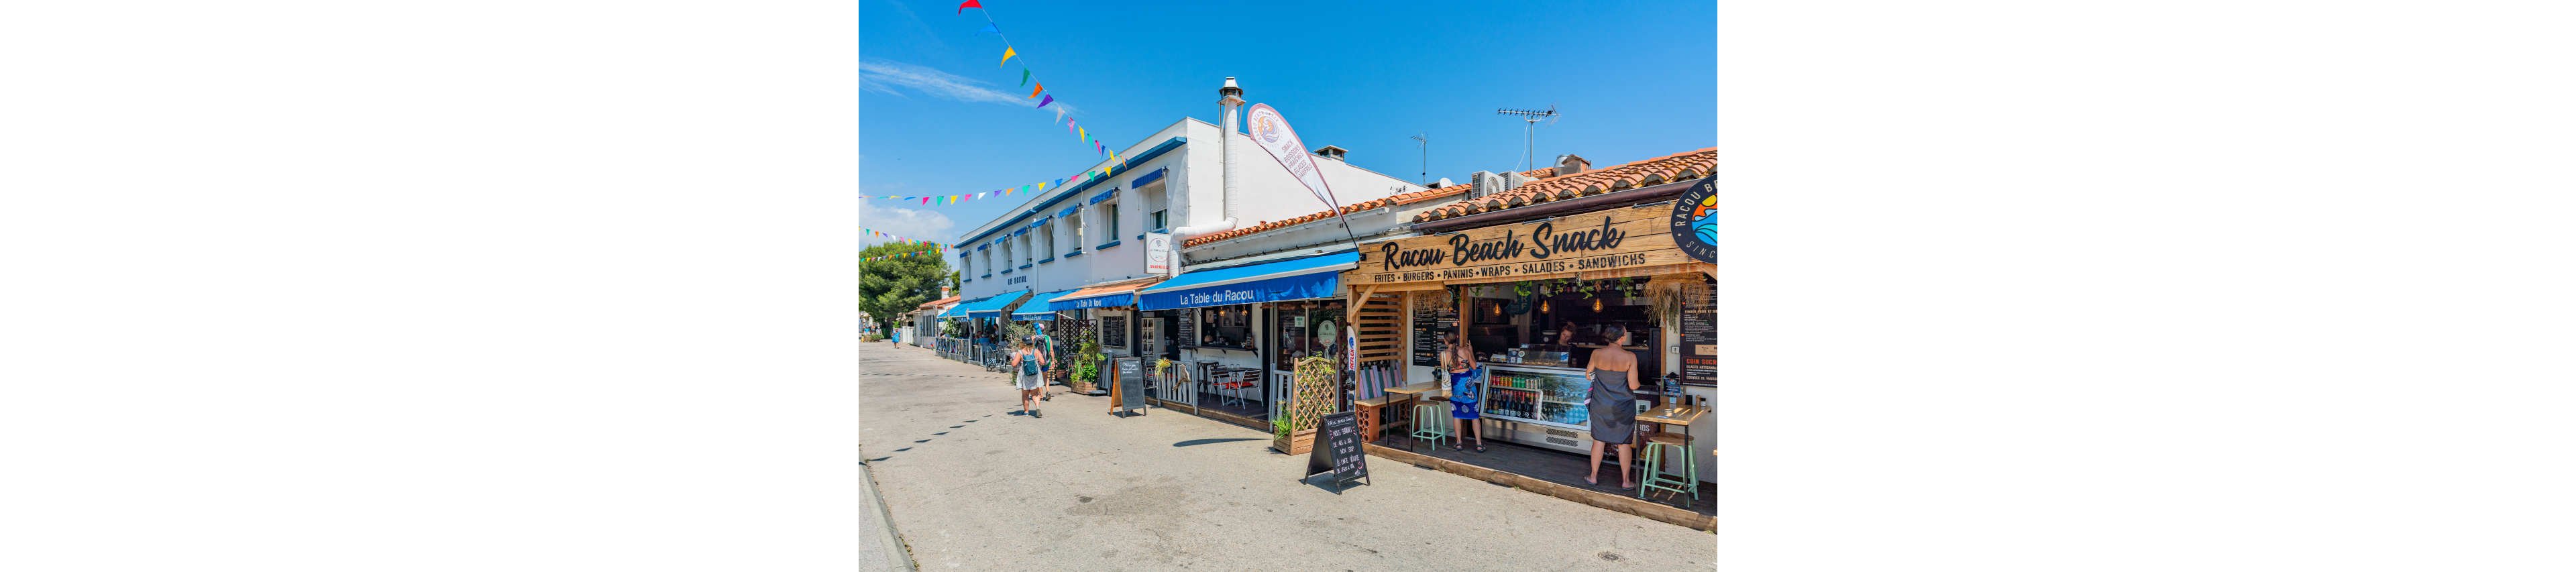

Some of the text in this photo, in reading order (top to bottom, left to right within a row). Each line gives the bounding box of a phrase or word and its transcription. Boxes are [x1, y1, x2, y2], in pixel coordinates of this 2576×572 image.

[1674, 191, 1701, 226] RACOU
[1382, 215, 1626, 272] Racou Beach Snack
[1686, 241, 1715, 258] SINC
[1375, 253, 1646, 282] FRITES BURGERS PANINIS WRAPS SALADES SANDWICHS
[1180, 290, 1254, 305] La Table du Racou
